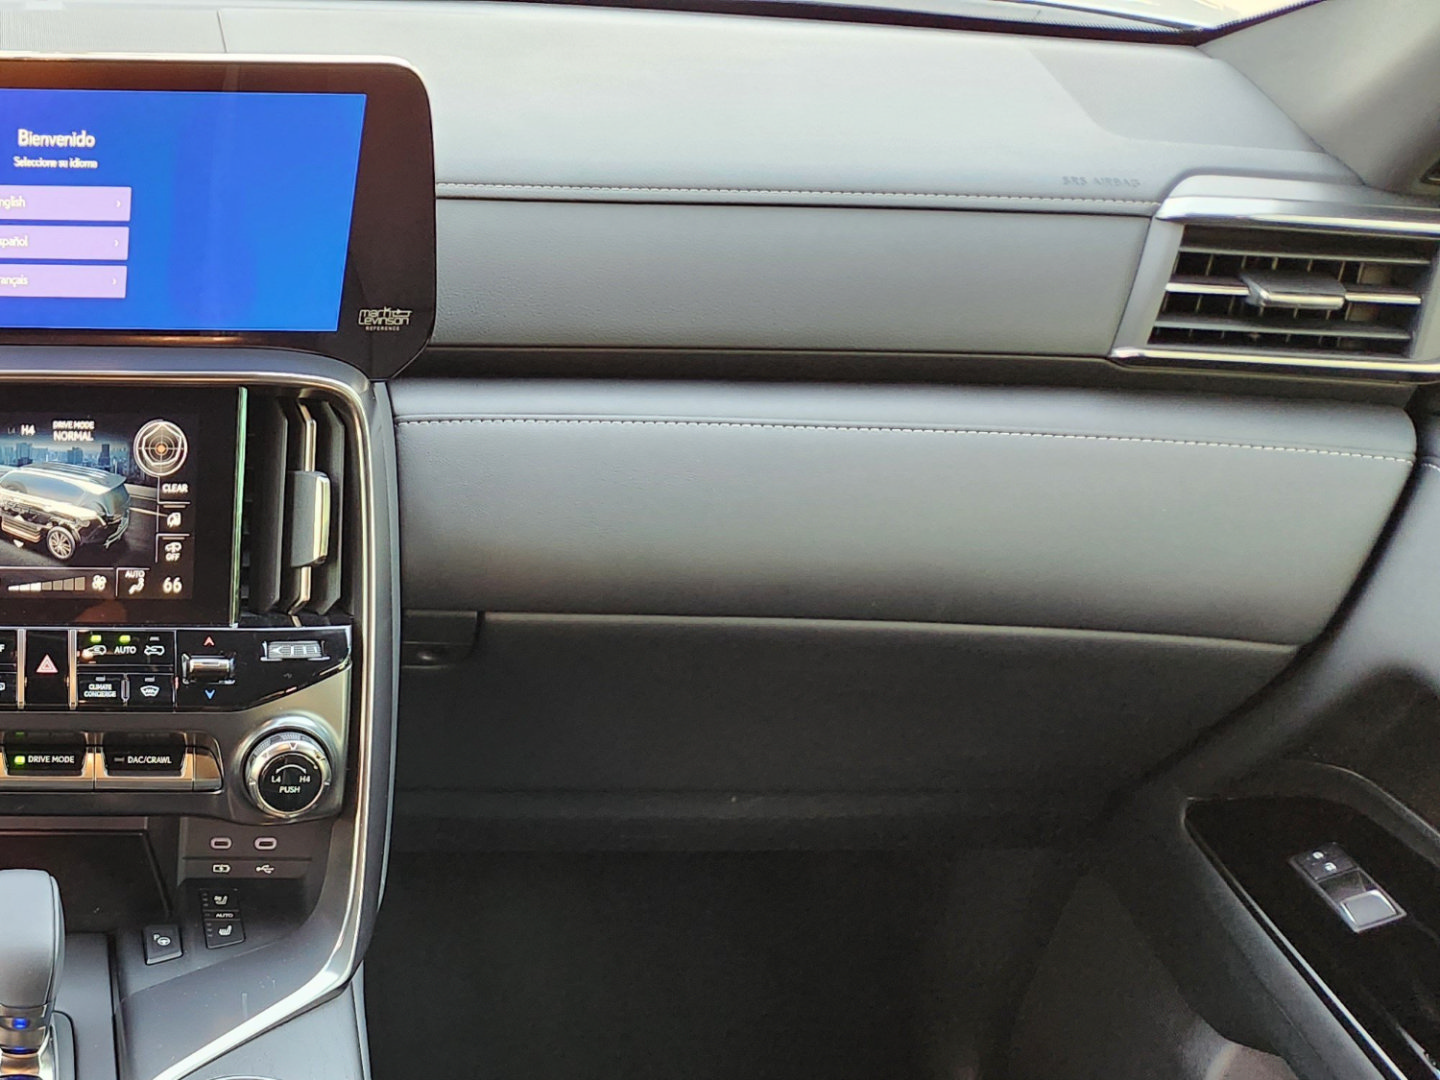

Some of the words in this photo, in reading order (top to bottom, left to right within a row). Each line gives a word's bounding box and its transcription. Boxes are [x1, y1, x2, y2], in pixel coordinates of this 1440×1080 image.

[17, 128, 97, 149] Bienvenido
[13, 156, 57, 168] Seleccione
[69, 157, 98, 169] idioma
[20, 424, 36, 436] H4
[73, 420, 95, 430] MODE
[53, 431, 93, 442] NORMAL
[161, 483, 188, 493] CLEAR
[165, 552, 181, 562] OFF
[125, 569, 146, 578] AUTO
[162, 576, 183, 593] 66
[114, 645, 137, 655] AUTO
[27, 755, 51, 764] DRIVE
[51, 755, 75, 764] MODE
[127, 755, 172, 765] DAC/CRAWL
[279, 786, 301, 794] PUSH
